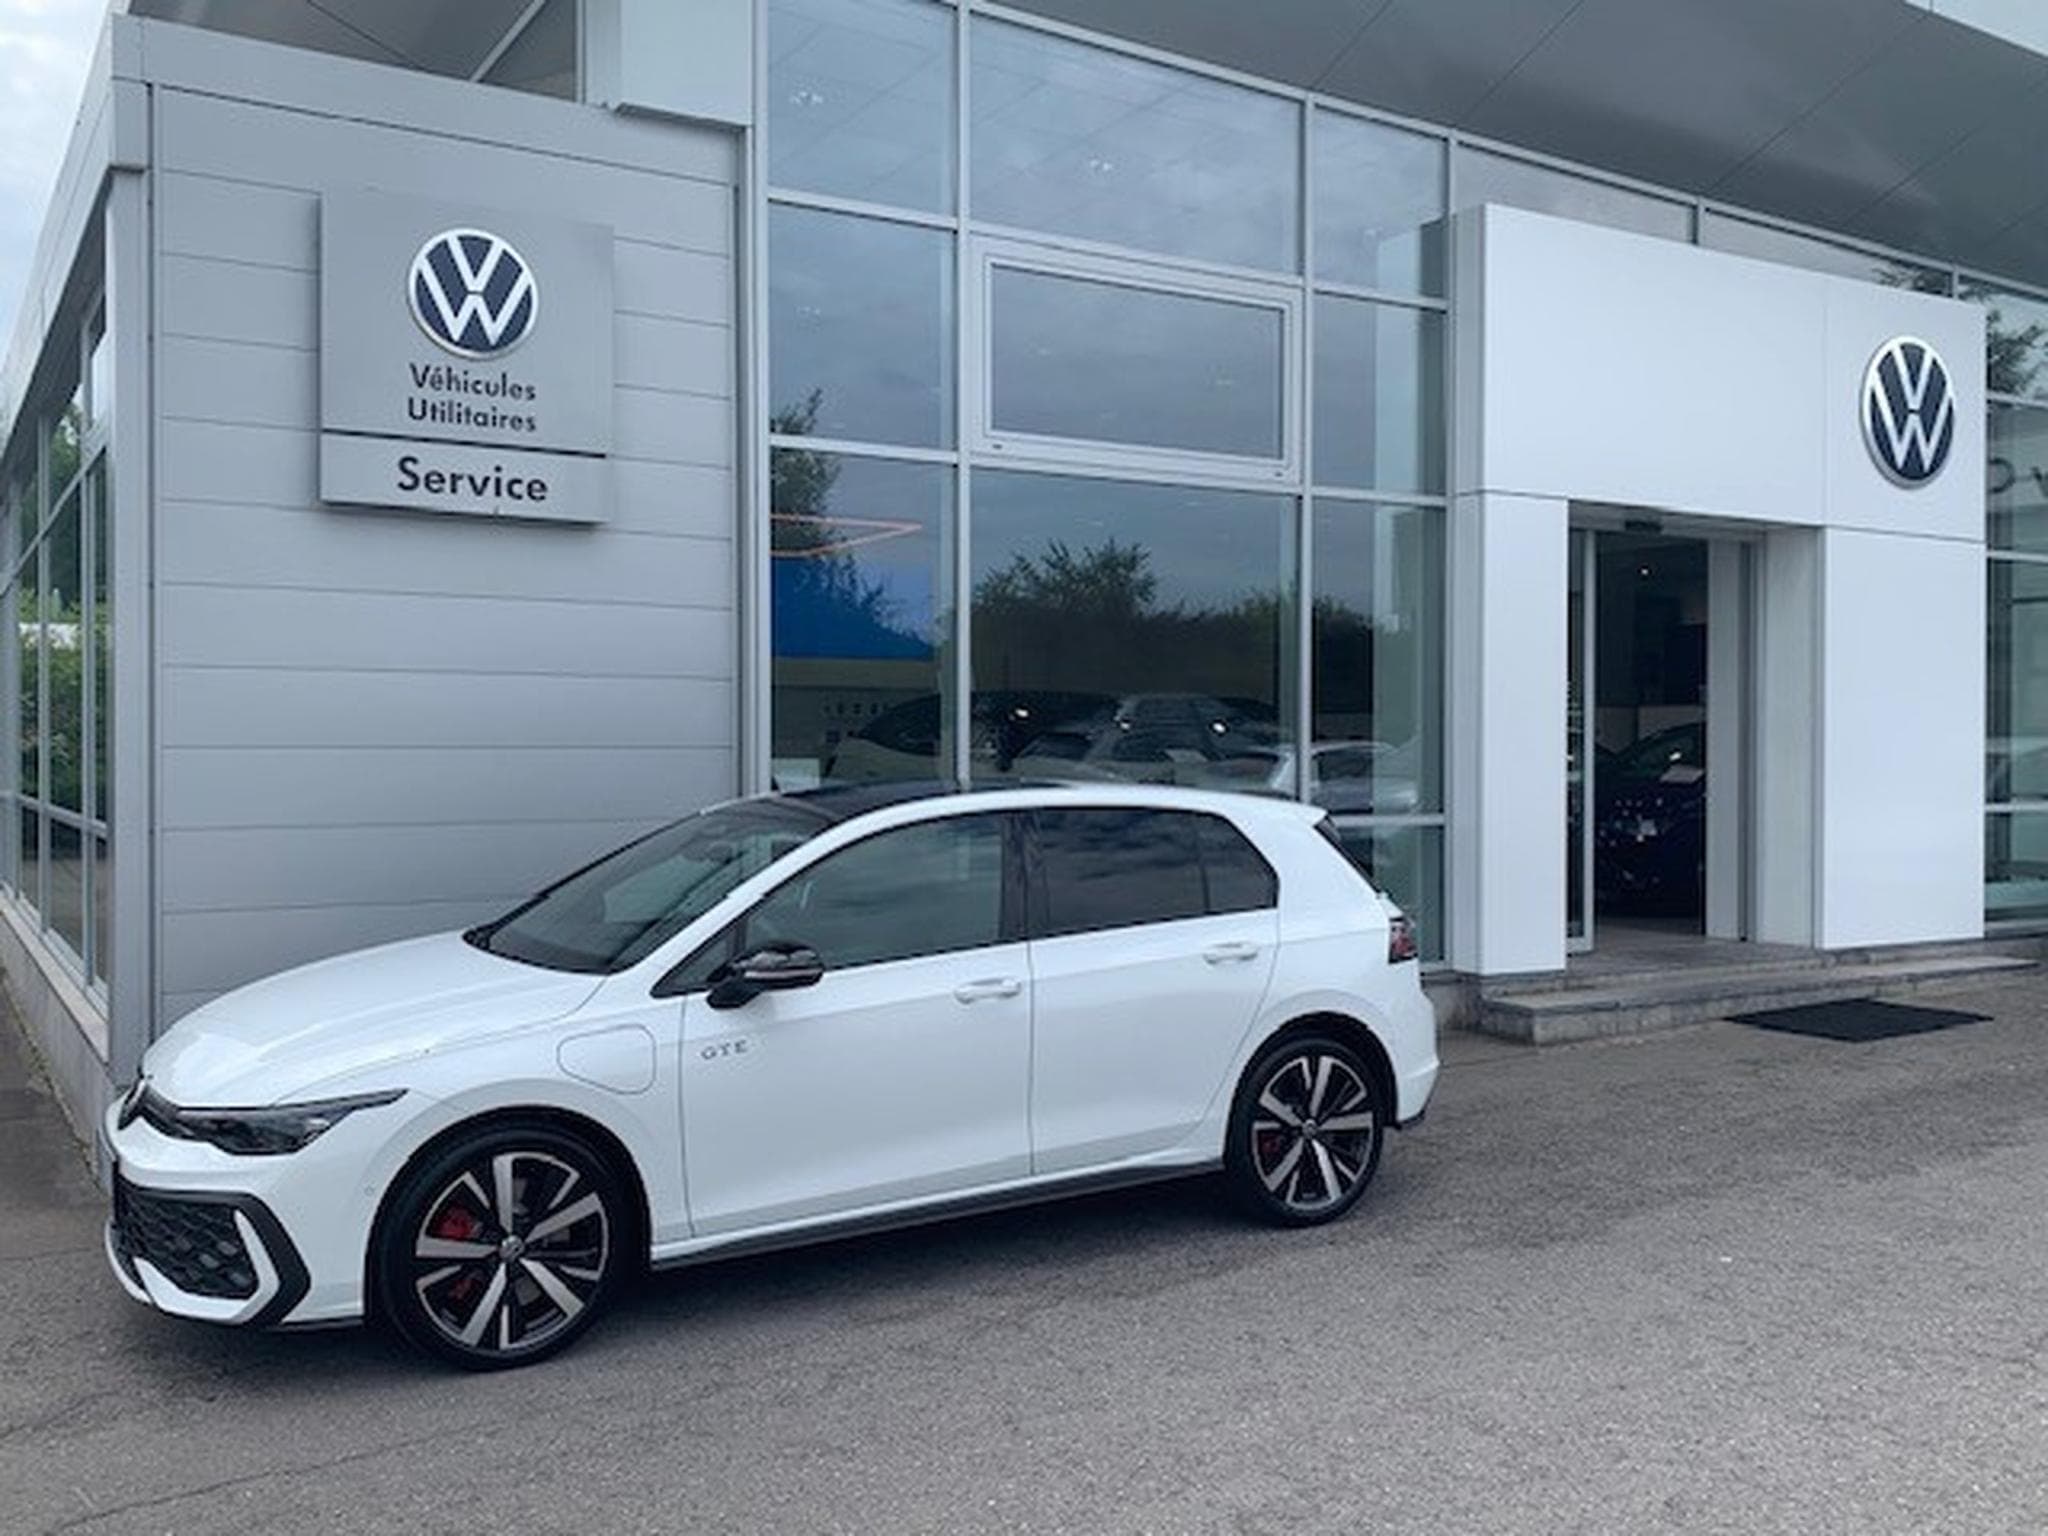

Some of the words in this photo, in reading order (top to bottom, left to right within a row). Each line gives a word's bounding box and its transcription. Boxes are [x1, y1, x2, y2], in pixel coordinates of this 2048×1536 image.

[409, 362, 536, 401] Véhicules
[408, 397, 536, 432] Utilitaires
[397, 455, 548, 501] Service
